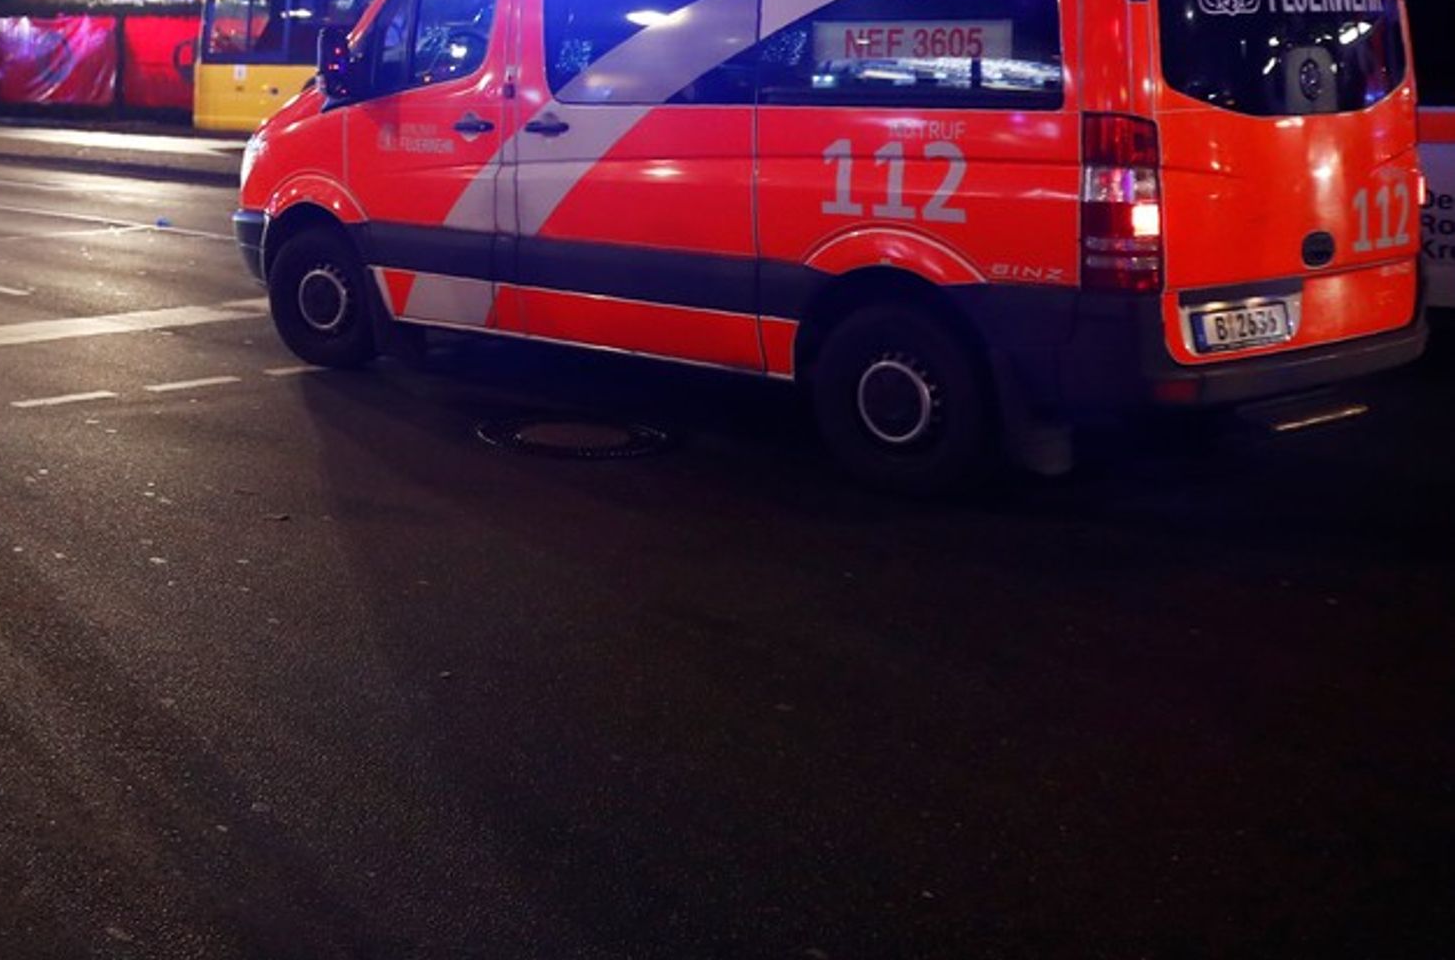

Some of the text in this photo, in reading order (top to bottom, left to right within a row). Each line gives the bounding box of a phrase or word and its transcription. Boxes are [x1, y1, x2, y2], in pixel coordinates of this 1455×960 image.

[845, 26, 981, 58] NEF 3605
[821, 138, 967, 224] 112
[1352, 182, 1410, 253] 112
[1215, 316, 1228, 341] B
